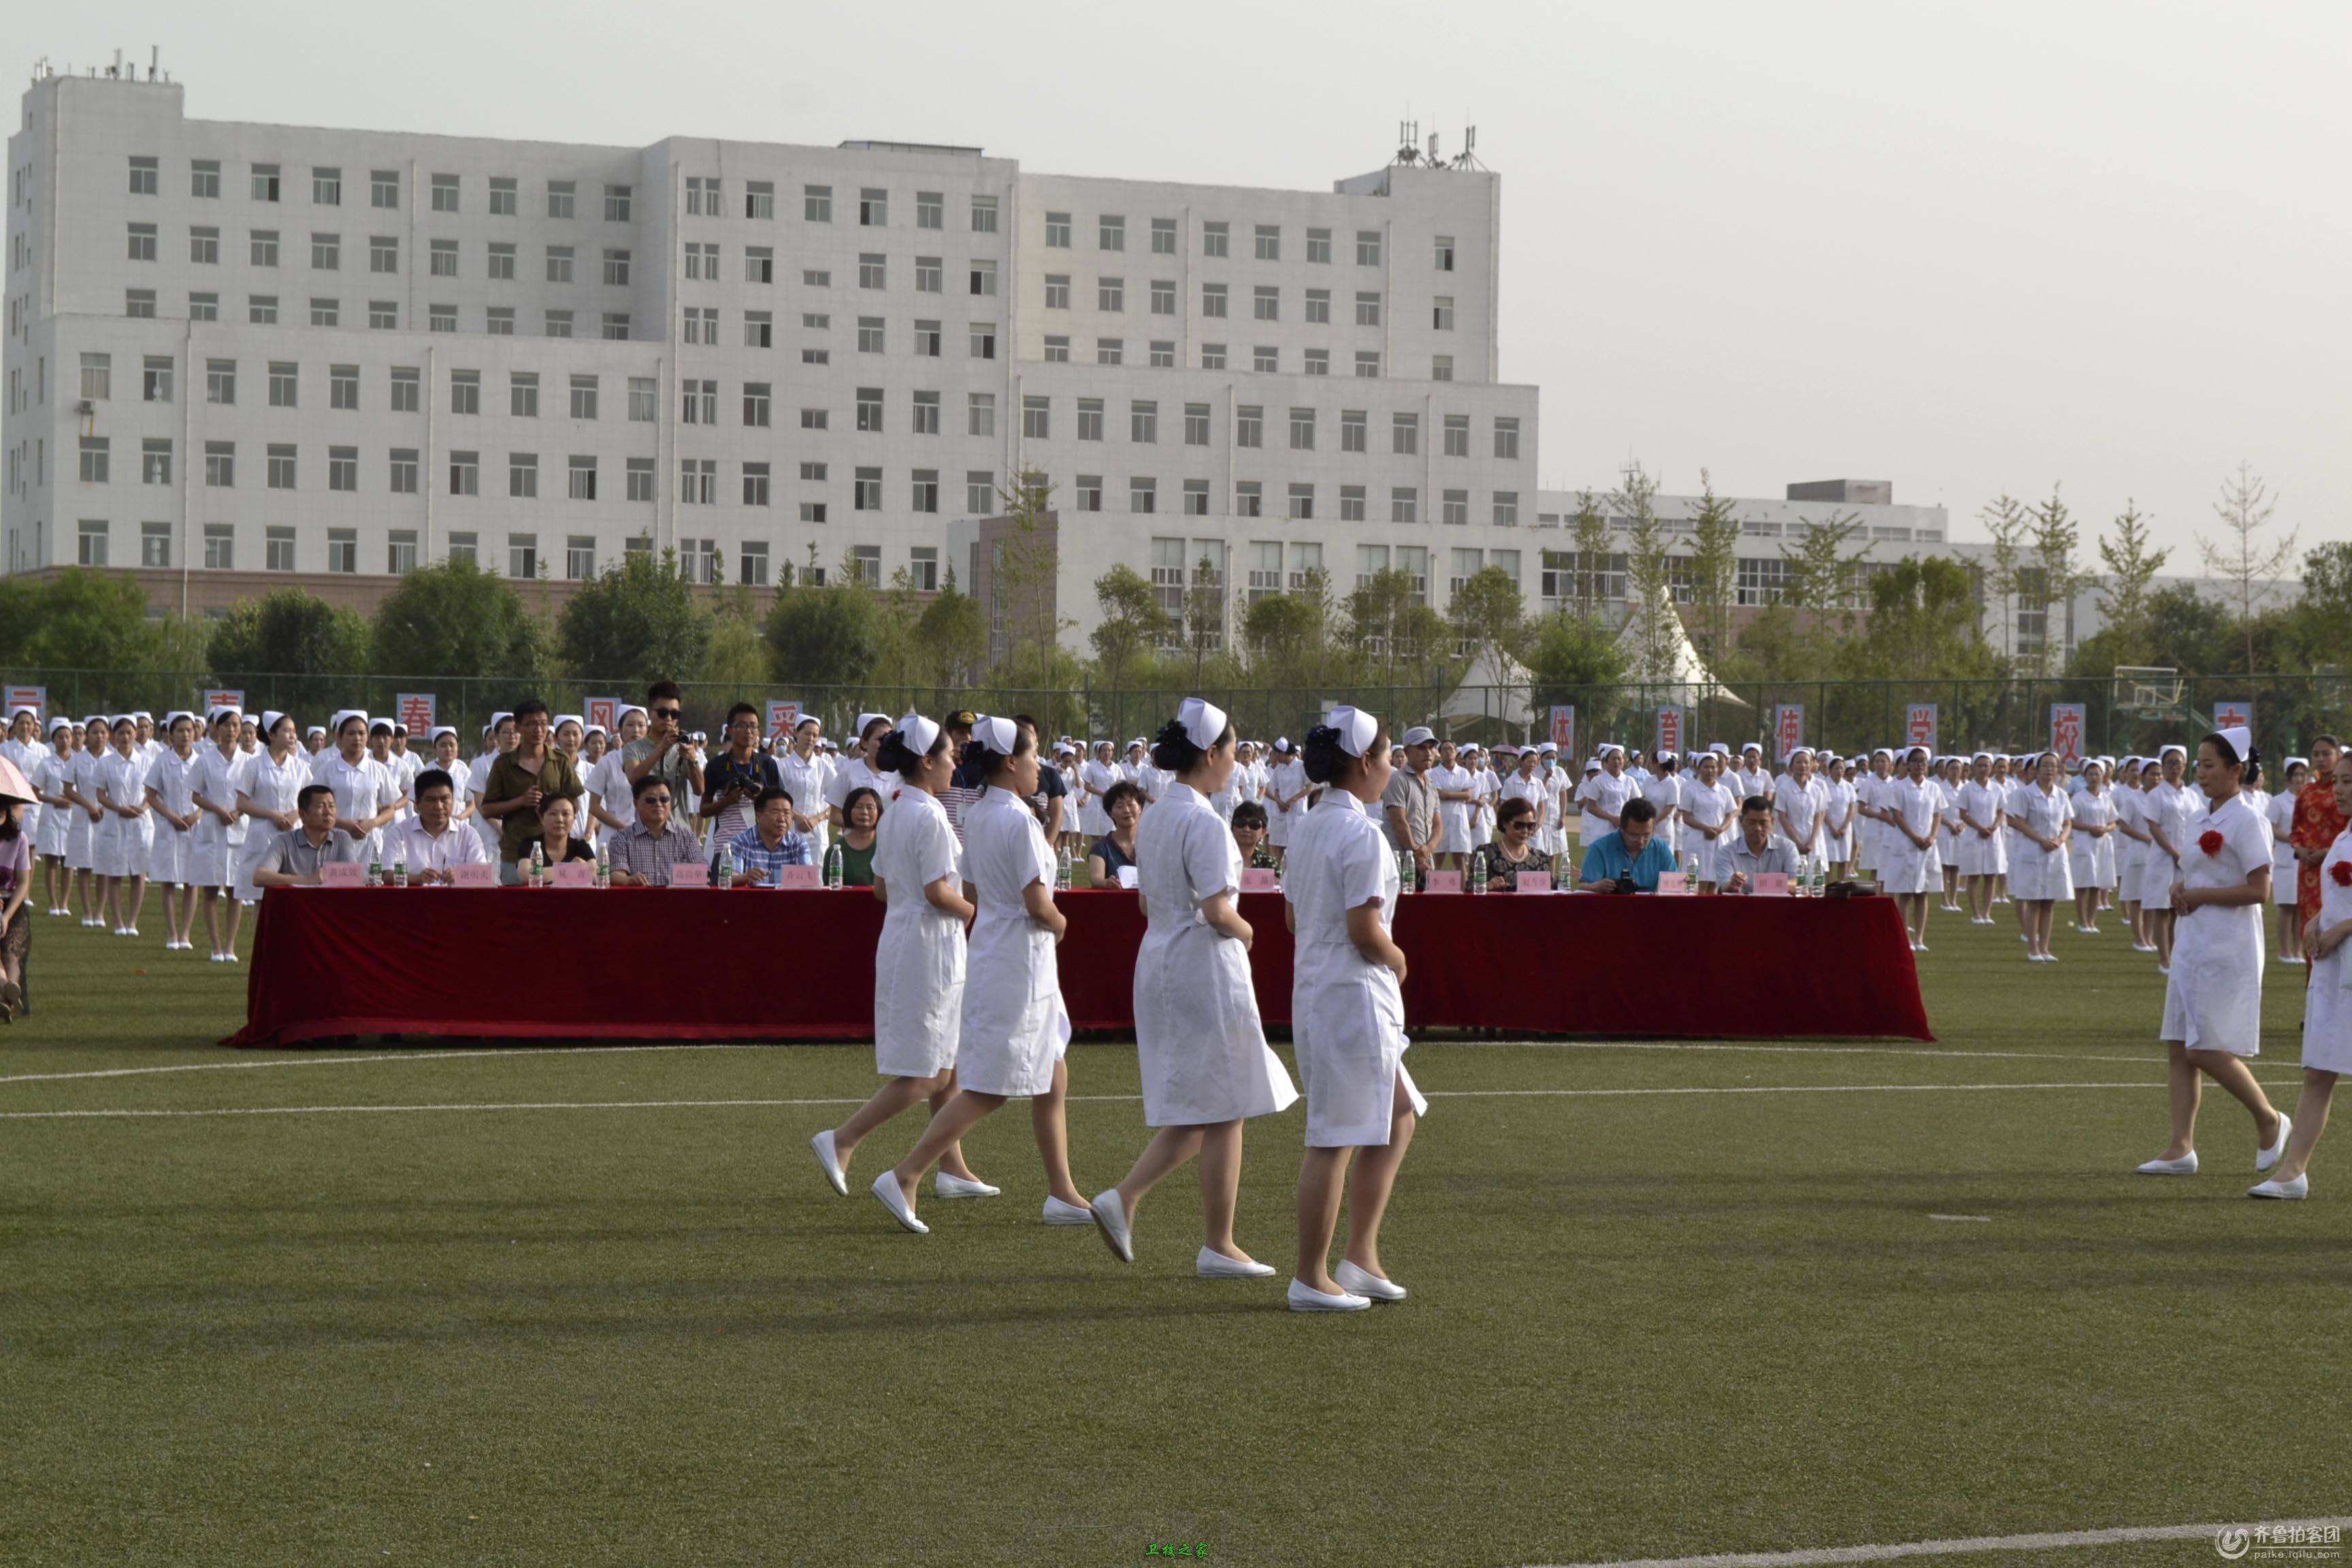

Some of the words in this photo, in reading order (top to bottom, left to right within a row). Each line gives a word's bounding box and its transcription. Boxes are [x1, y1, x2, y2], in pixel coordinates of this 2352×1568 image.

[400, 697, 431, 736] 春
[590, 701, 619, 735] 风
[770, 705, 796, 738] 采
[1552, 709, 1571, 756] 体
[1661, 710, 1679, 751] 育
[1777, 708, 1799, 760] 使
[1910, 709, 1931, 748] 学
[2053, 708, 2079, 763] 校
